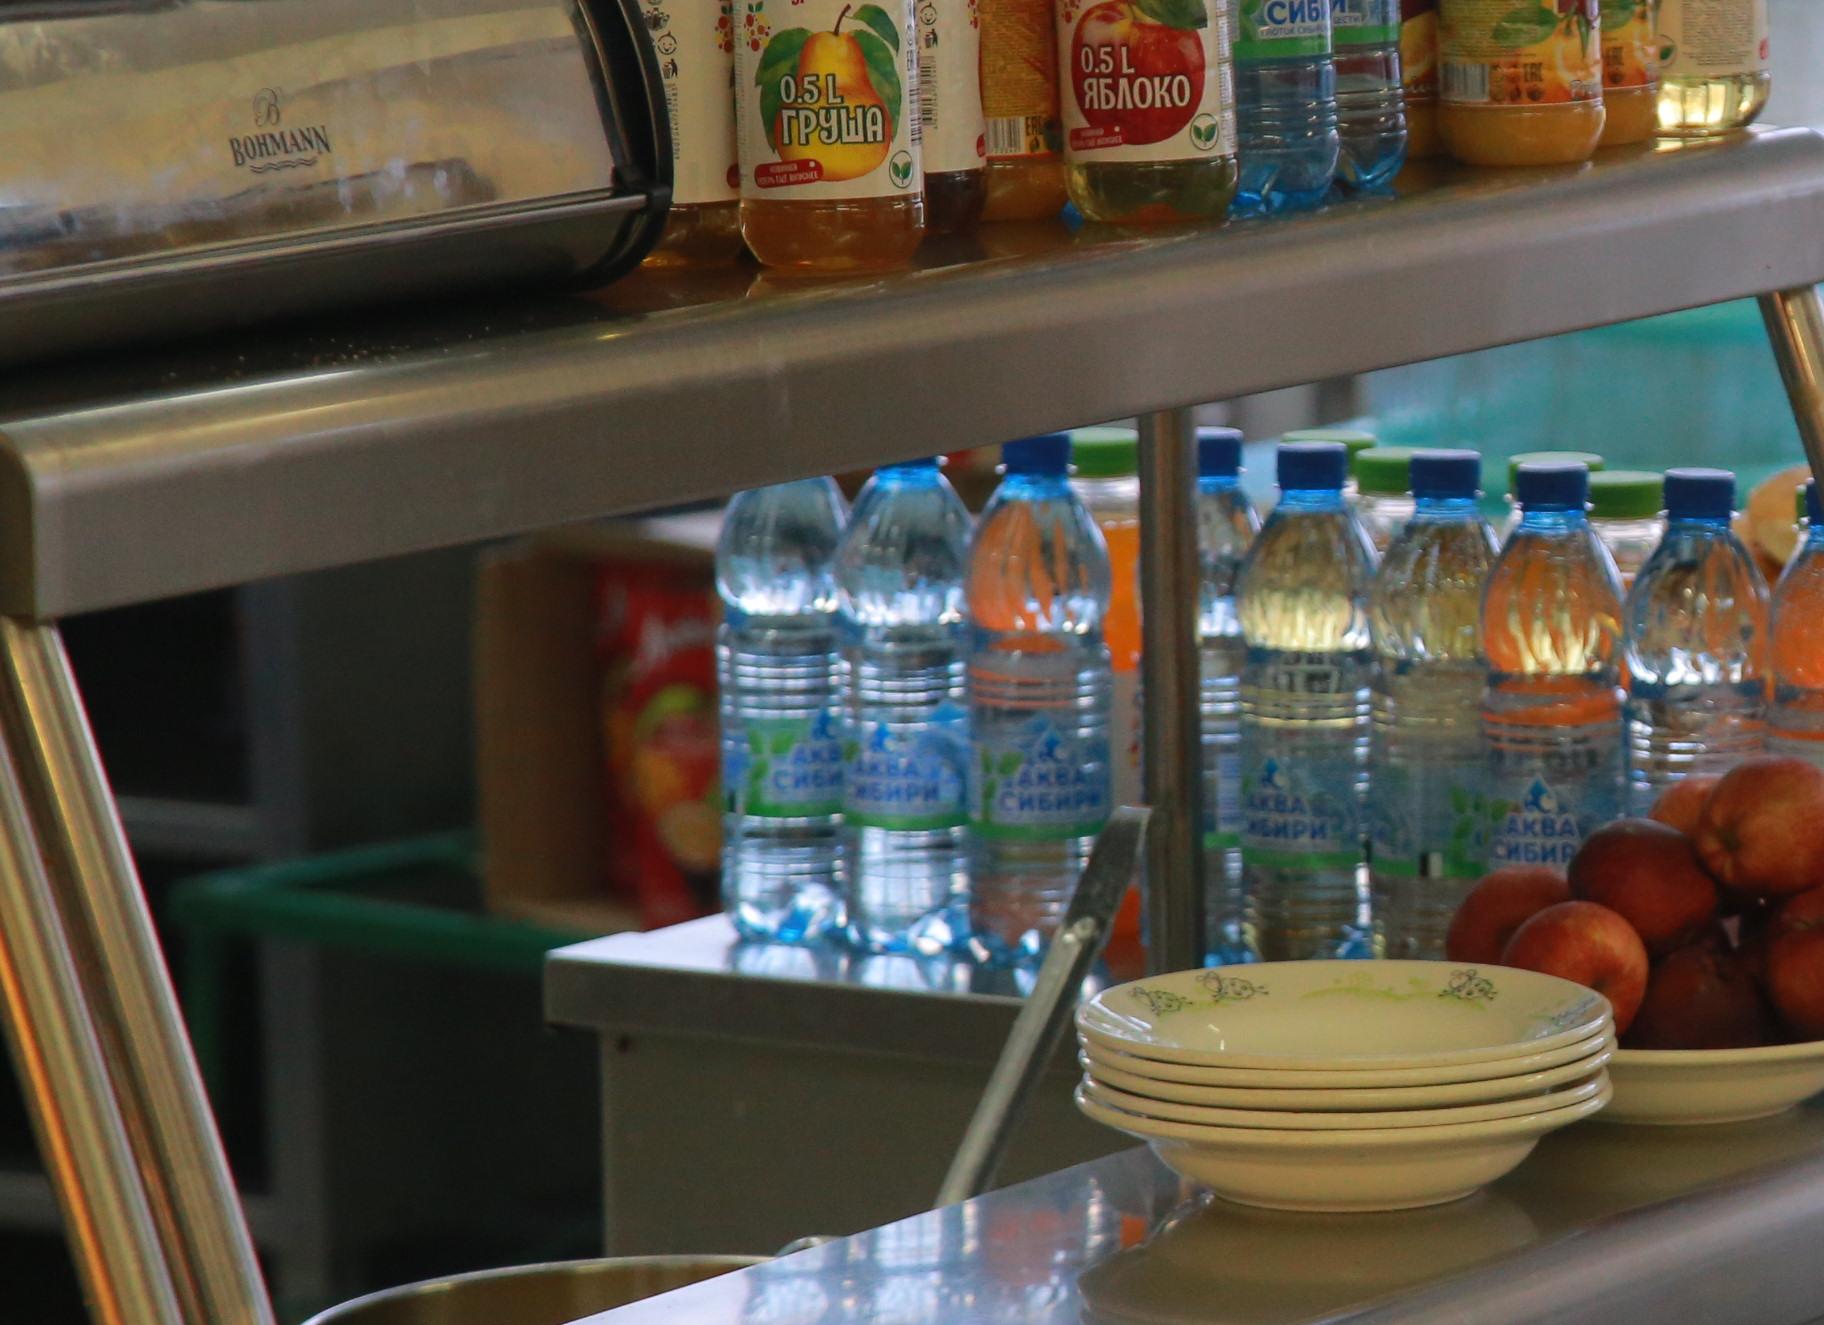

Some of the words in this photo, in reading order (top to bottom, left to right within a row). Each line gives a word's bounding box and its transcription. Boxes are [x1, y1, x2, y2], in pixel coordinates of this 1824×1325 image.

[1266, 1, 1330, 25] СИБ
[1081, 46, 1113, 74] 0.5
[1121, 46, 1136, 74] L
[780, 75, 819, 104] 0.5
[826, 75, 843, 104] L
[1083, 75, 1191, 110] ЯБЛОКО
[781, 105, 884, 145] ГРУША
[229, 125, 332, 167] BOHMANN
[774, 768, 843, 792] СИБИ
[851, 780, 940, 802] ИБИРИ
[1505, 814, 1577, 837] АКВА
[1492, 840, 1577, 864] СИБИР
